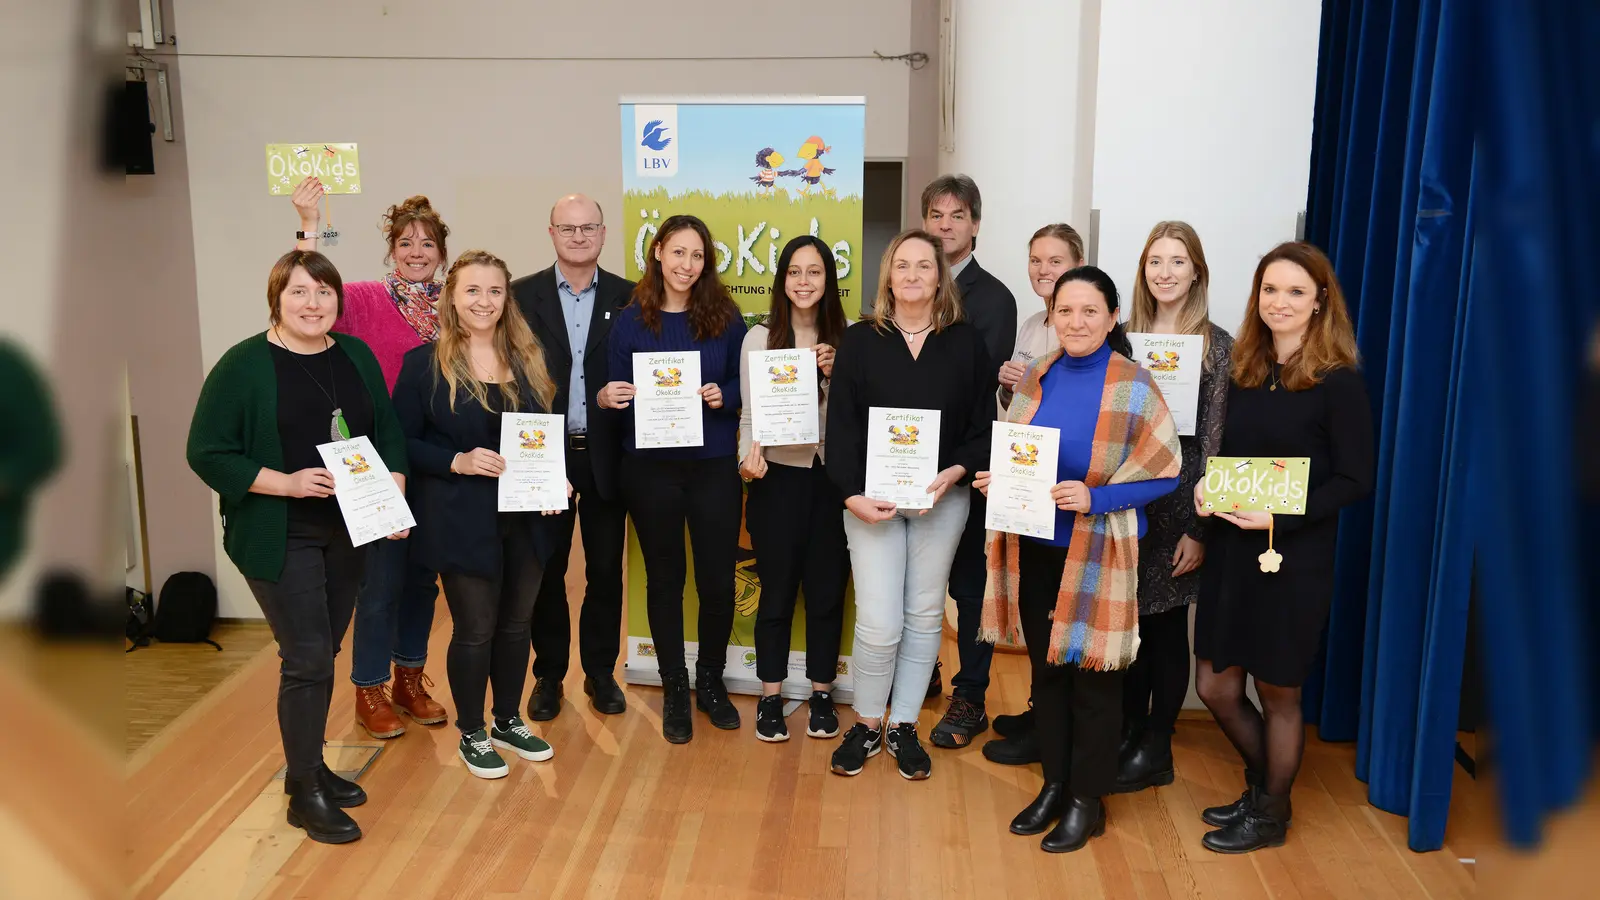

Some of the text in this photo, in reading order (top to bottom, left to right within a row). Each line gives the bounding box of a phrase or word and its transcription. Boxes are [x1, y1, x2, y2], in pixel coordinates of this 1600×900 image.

[268, 151, 358, 177] ÖkoKids
[643, 157, 671, 170] LBV
[725, 285, 765, 295] CHTUNG
[1144, 338, 1185, 348] Zertifikat
[648, 357, 685, 366] Zertifikat
[764, 354, 801, 363] Zertifikat
[516, 418, 550, 427] Zertifikat
[885, 413, 925, 422] Zertifikat
[1007, 428, 1044, 441] Zertifikat
[1205, 465, 1304, 499] ÖkoKids
